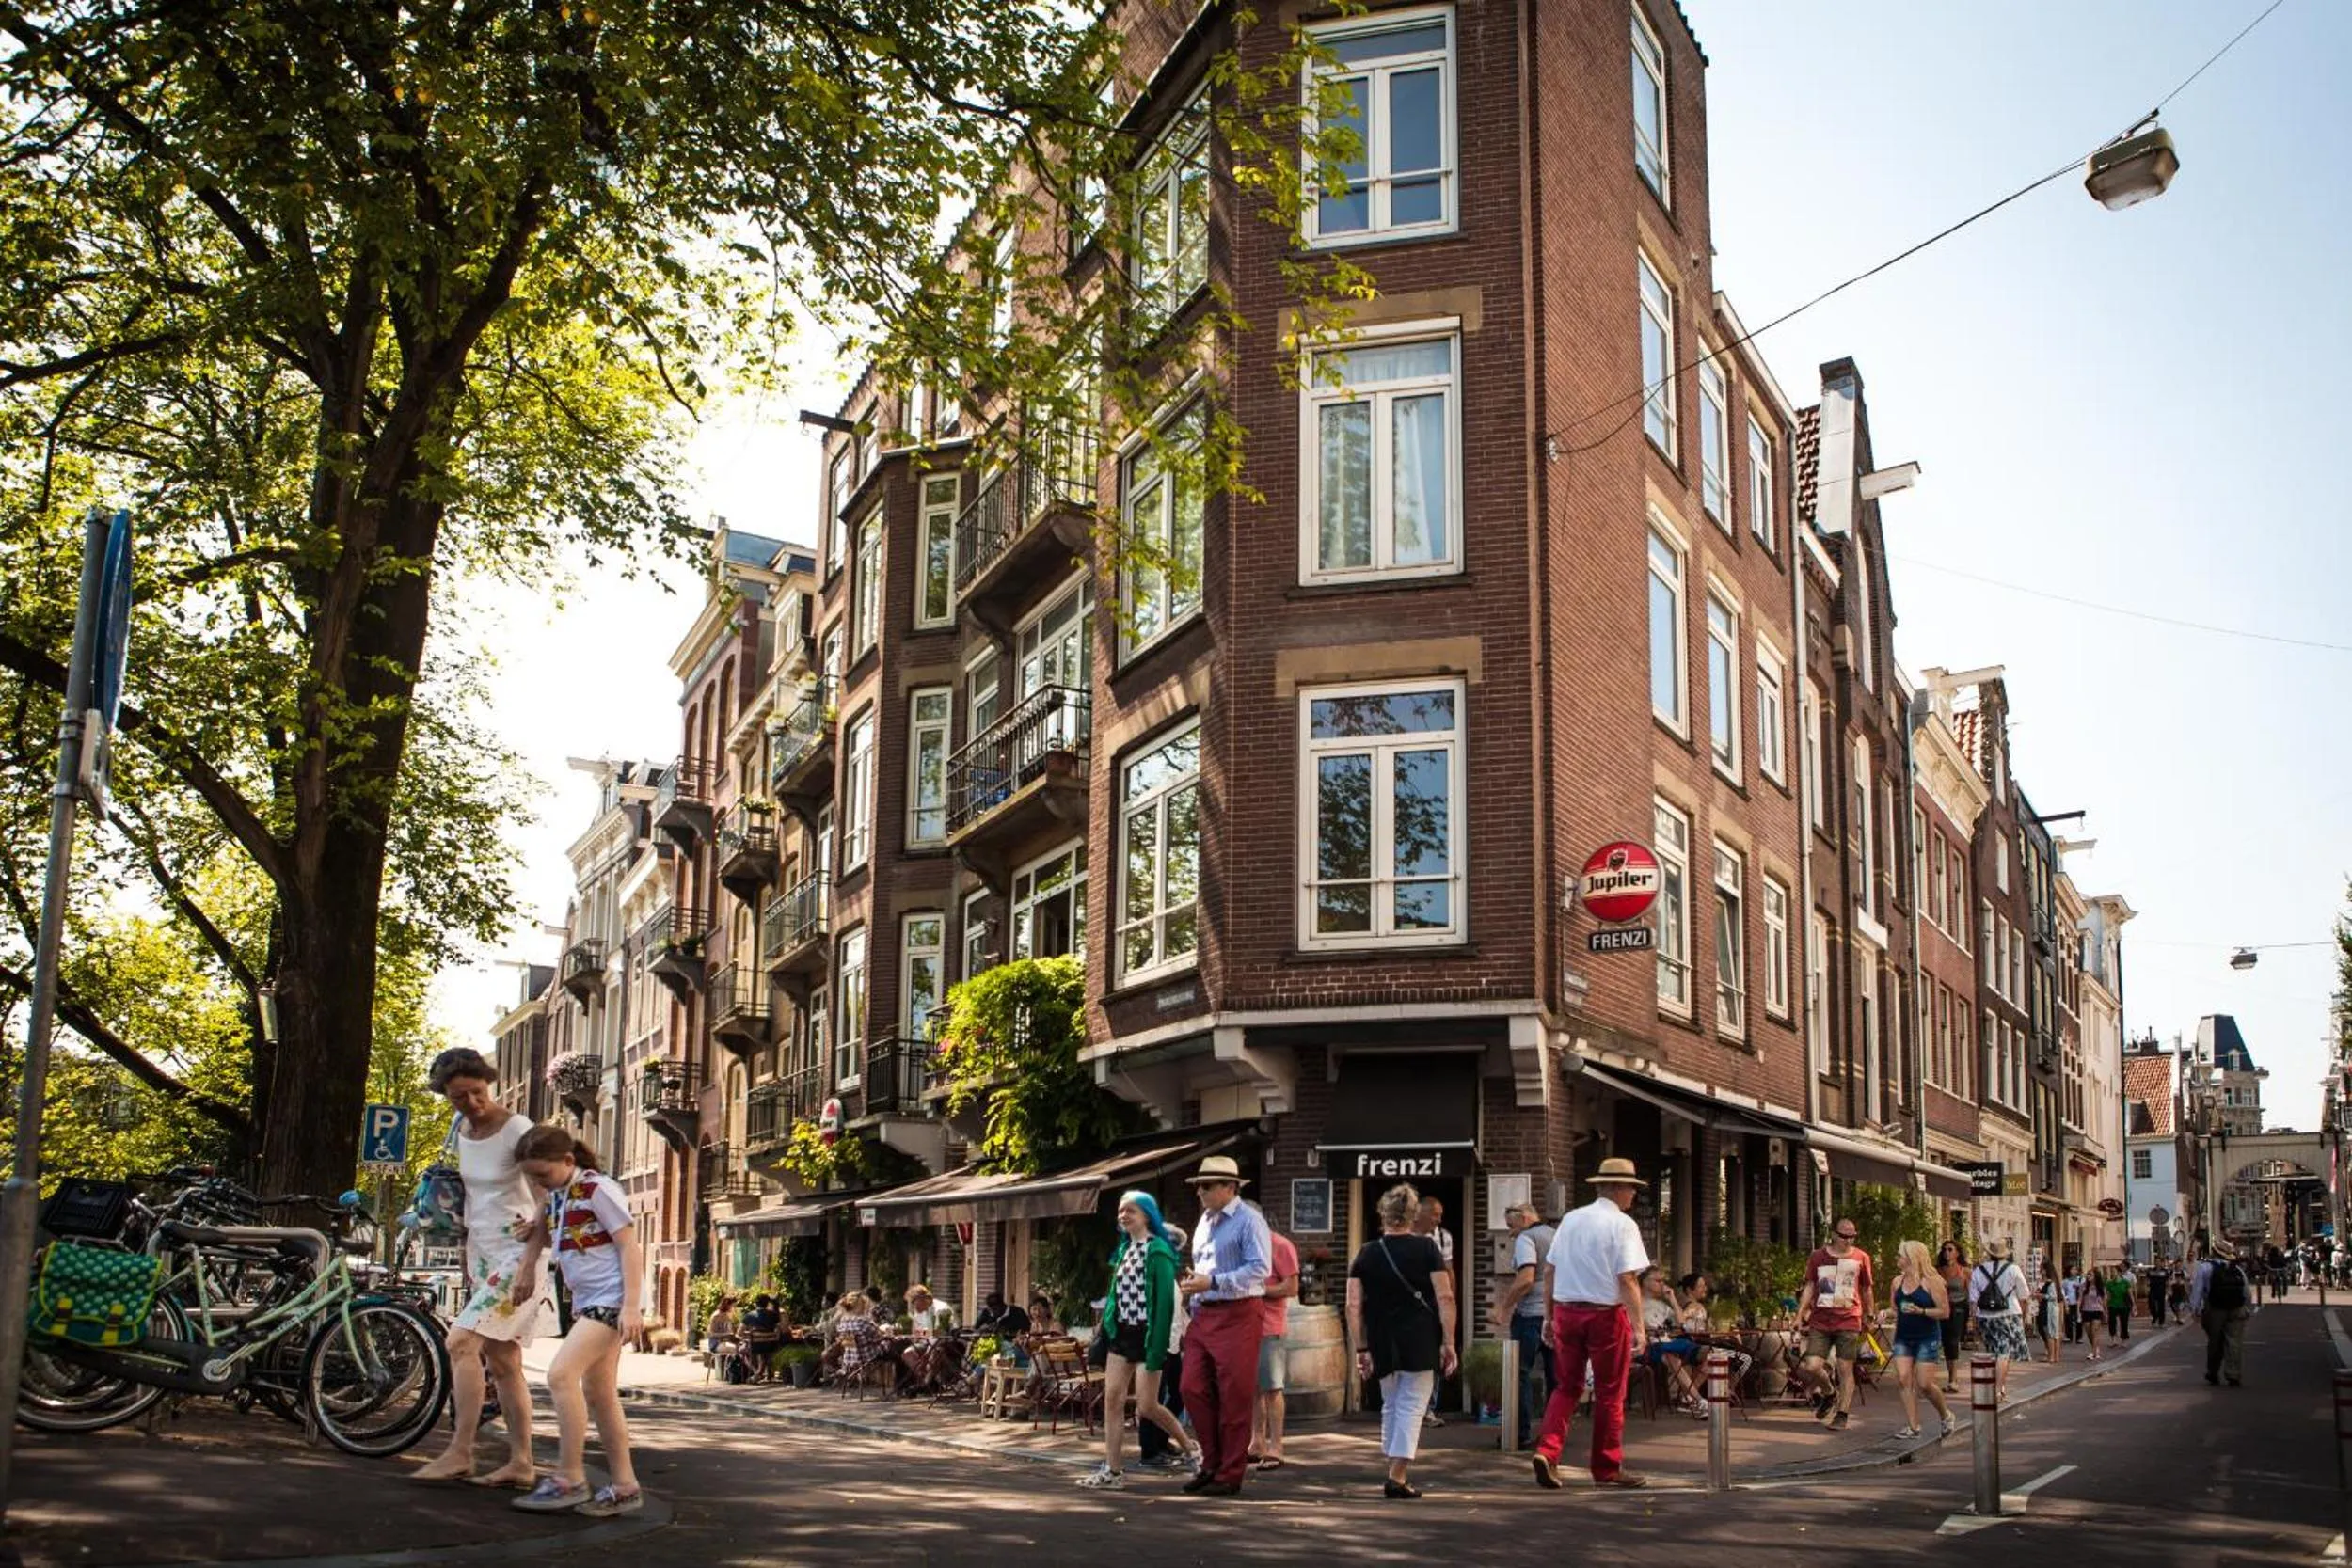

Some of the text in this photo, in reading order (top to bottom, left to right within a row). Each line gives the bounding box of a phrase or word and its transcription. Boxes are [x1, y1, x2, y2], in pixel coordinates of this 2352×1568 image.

[1585, 871, 1653, 895] Jupiler
[1592, 930, 1647, 950] FRENZI
[374, 1110, 399, 1138] P
[1357, 1151, 1442, 1177] frenzi
